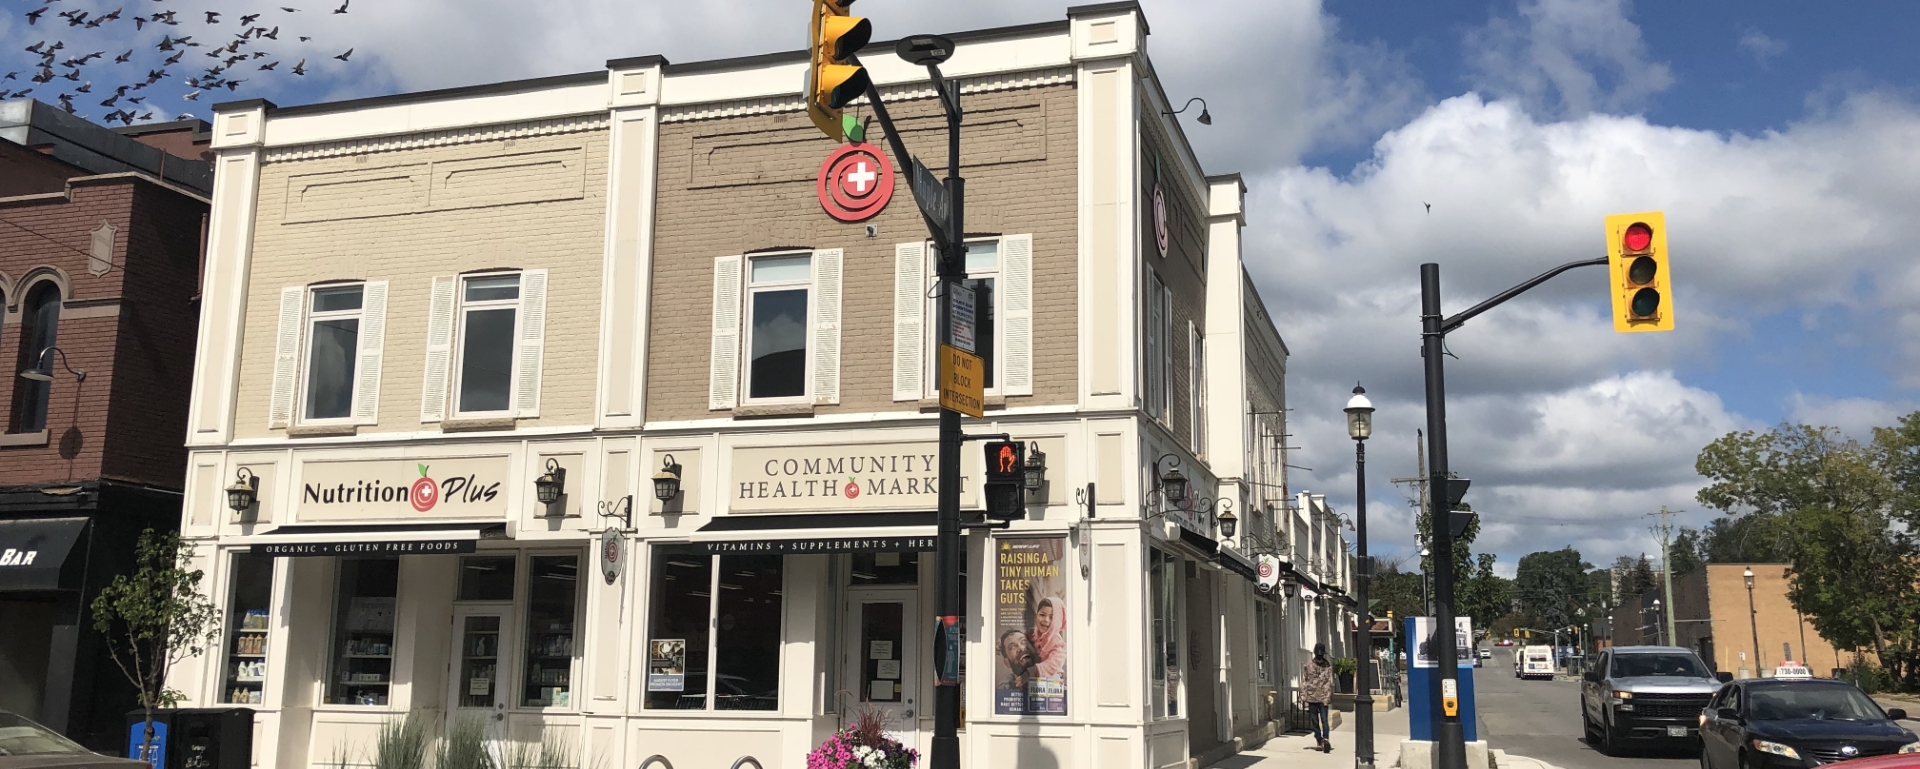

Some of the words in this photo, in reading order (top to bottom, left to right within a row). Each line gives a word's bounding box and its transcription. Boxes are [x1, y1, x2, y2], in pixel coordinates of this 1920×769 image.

[953, 354, 960, 366] DO
[962, 357, 972, 370] NOT
[954, 372, 971, 389] BLOCK
[944, 387, 980, 410] INTERSECTION
[765, 455, 935, 476] COMMUNITY
[303, 480, 409, 504] Nutrition
[441, 474, 501, 503] Plus
[739, 480, 838, 498] HEALTH
[867, 476, 969, 495] MARKT
[266, 545, 316, 553] ORGANIC
[335, 543, 379, 552] GLUTEN
[386, 543, 413, 551] FREE
[420, 542, 458, 550] FOODS
[707, 542, 771, 551] VITAMINS
[792, 540, 887, 550] SUPPLEMENTS
[908, 539, 934, 548] HER
[1000, 552, 1040, 564] RAISING
[1041, 552, 1049, 564] A
[1000, 565, 1022, 578] TINY
[1024, 565, 1059, 577] HUMAN
[1000, 579, 1030, 591] TAKES
[1000, 592, 1027, 604] GUTS.
